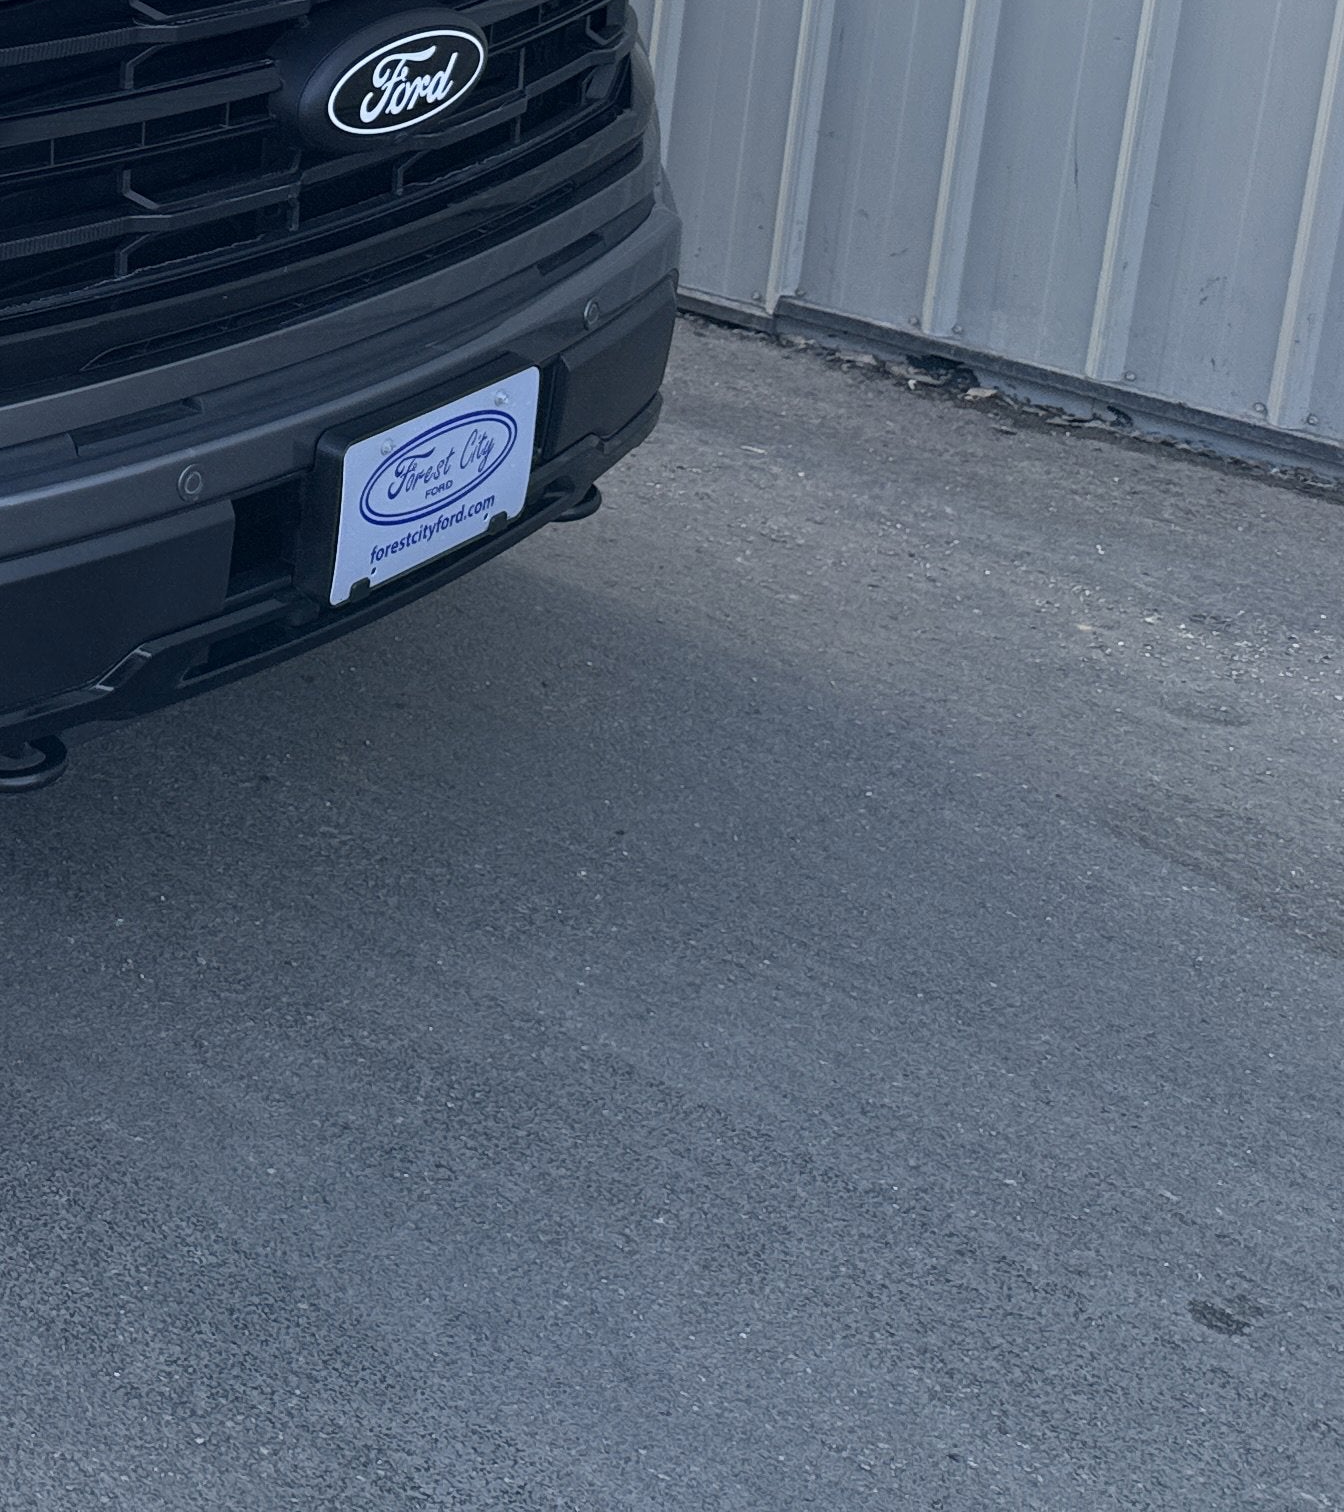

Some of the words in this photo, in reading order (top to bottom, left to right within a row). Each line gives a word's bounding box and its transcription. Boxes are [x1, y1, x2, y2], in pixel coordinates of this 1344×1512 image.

[359, 45, 459, 123] Ford
[387, 446, 455, 500] Forest
[459, 428, 495, 473] City
[424, 479, 454, 500] FORD
[370, 494, 495, 565] forestcityford.com
